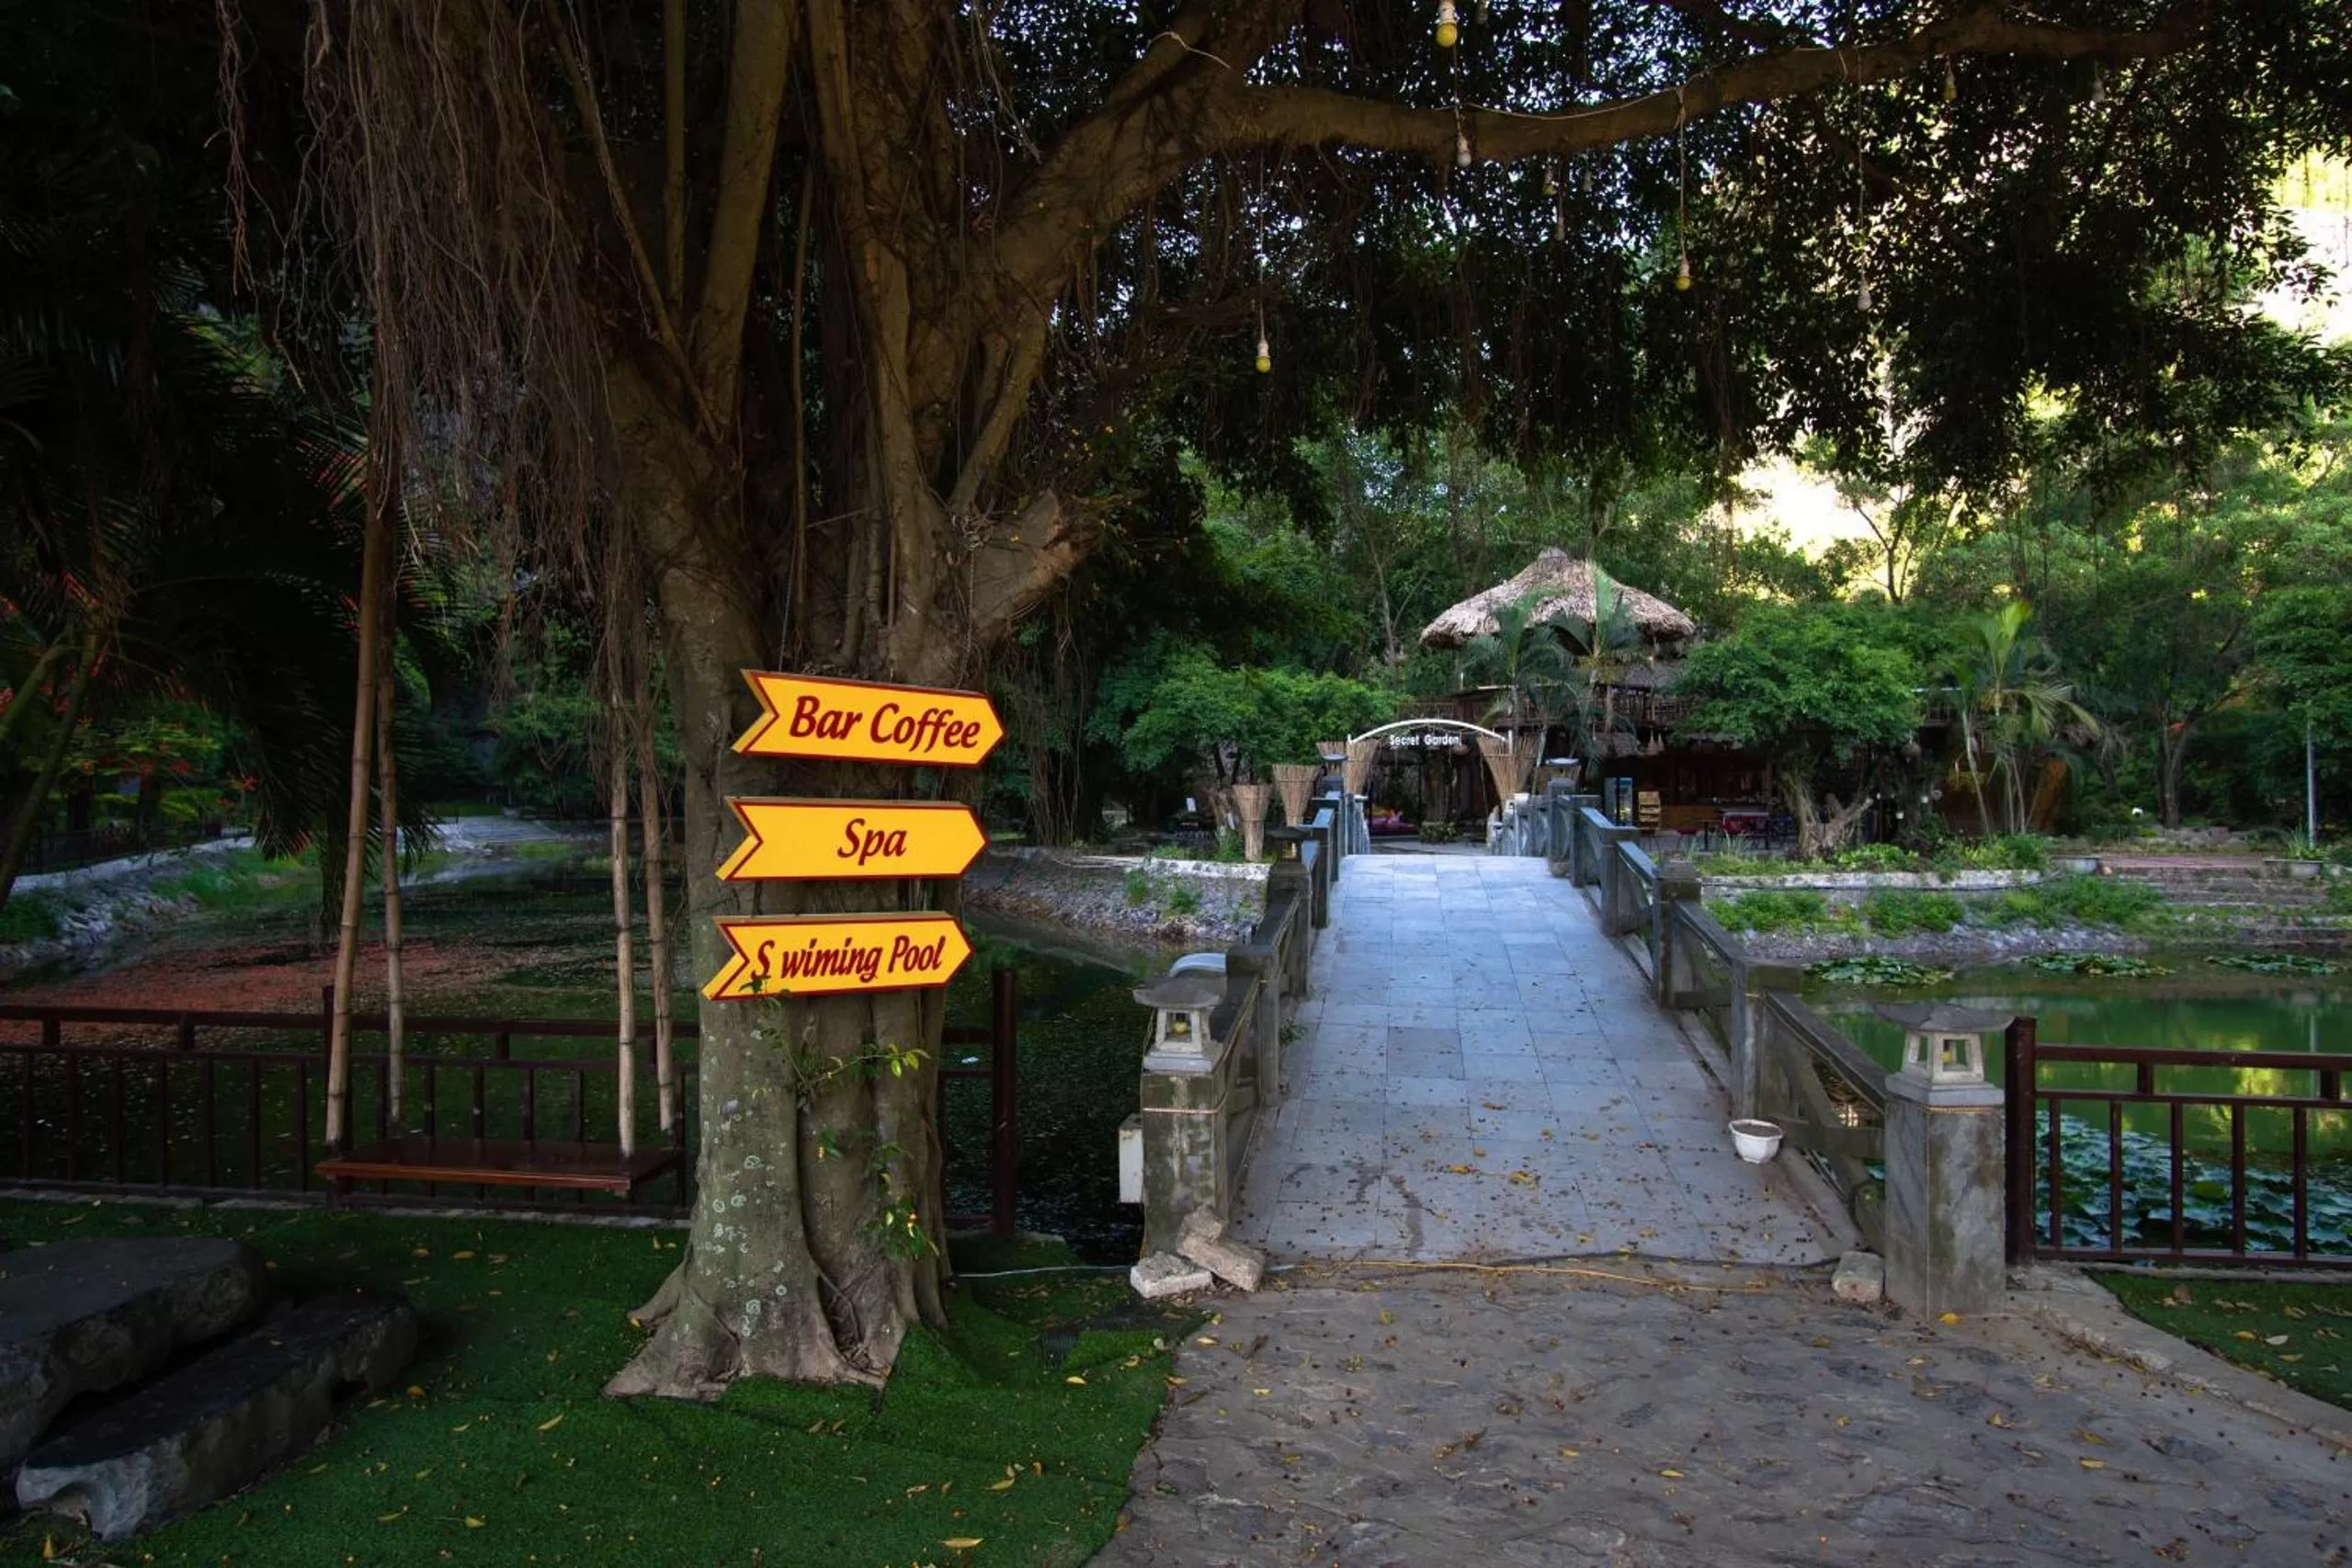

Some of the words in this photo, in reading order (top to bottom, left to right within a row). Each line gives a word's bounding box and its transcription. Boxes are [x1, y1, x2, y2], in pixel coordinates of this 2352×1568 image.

[789, 695, 863, 741] Bar
[869, 702, 981, 753] Coffee
[1390, 734, 1420, 745] Secret
[1425, 734, 1460, 745] Garden
[836, 817, 907, 866] Spa
[887, 936, 946, 973] Pool
